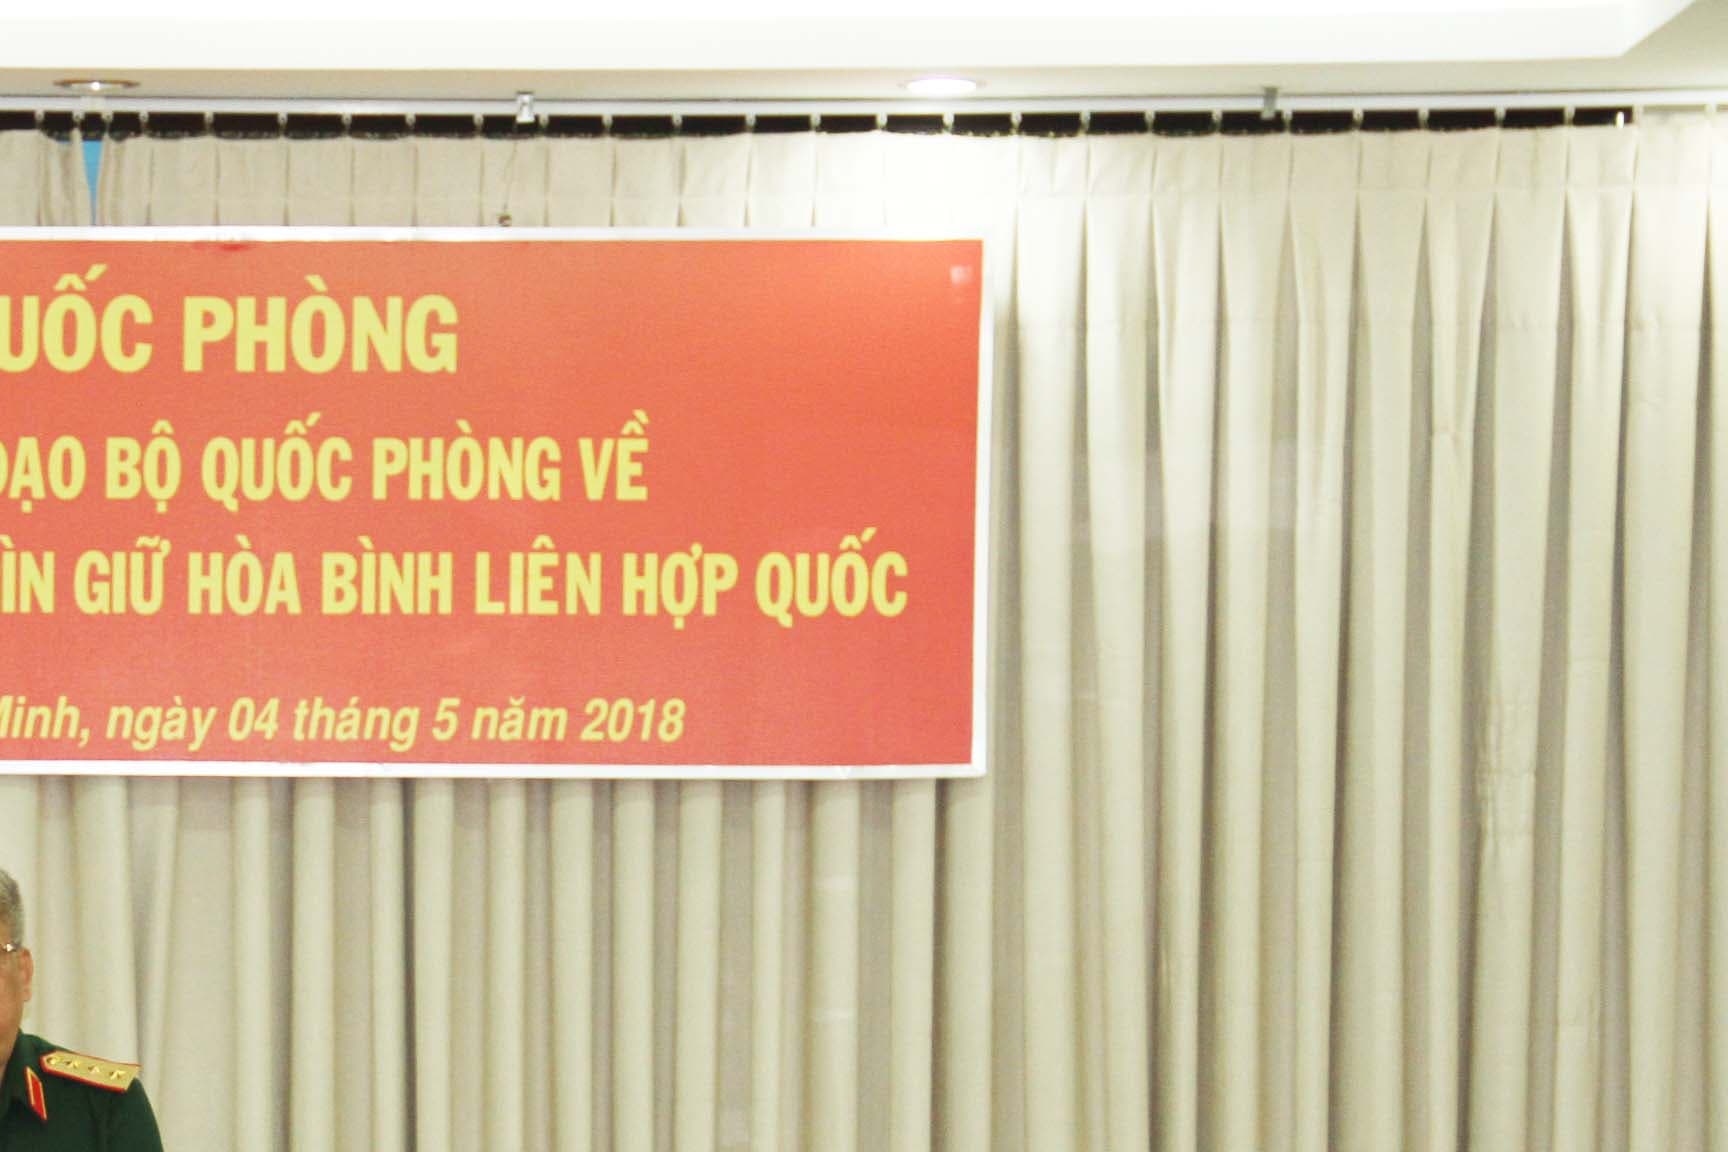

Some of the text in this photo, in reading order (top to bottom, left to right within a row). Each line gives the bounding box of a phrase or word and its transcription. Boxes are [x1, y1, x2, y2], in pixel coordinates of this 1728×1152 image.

[182, 273, 459, 375] PHÒNG
[105, 419, 182, 514] BỘ
[201, 411, 353, 513] QUỐC
[371, 418, 562, 502] PHÒNG
[578, 409, 650, 502] VỀ
[73, 535, 172, 616] GIỮ
[187, 533, 303, 617] HÒA
[320, 535, 454, 616] BÌNH
[474, 534, 602, 616] LIÊN
[622, 542, 739, 630] HỢP
[754, 526, 908, 629] QUỐC
[105, 695, 216, 751] ngày
[228, 697, 279, 742] 04
[292, 696, 421, 753] tháng
[432, 697, 460, 743] 5
[471, 694, 568, 742] năm
[580, 698, 686, 744] 2018
